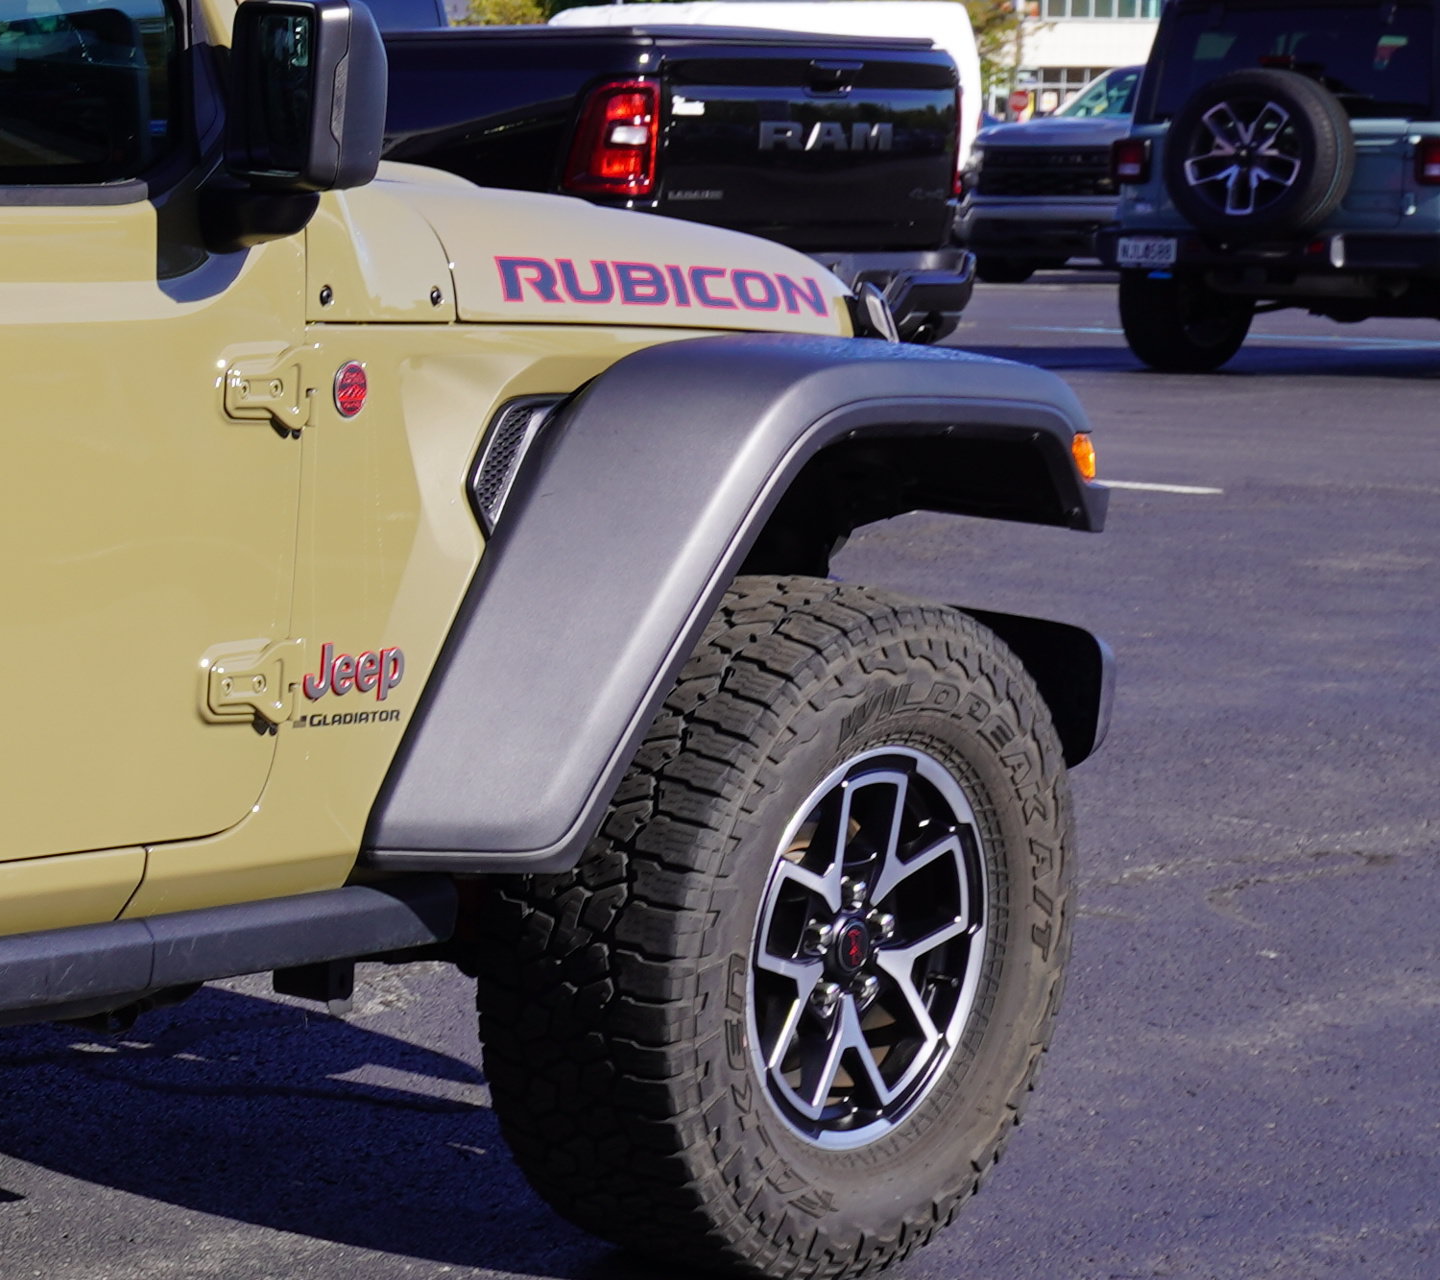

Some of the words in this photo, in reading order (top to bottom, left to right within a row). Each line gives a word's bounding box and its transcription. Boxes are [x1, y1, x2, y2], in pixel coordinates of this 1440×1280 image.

[759, 121, 894, 151] RAM
[493, 255, 830, 318] RUBICON
[302, 641, 405, 703] Jeep
[309, 709, 400, 728] GLADIATOR
